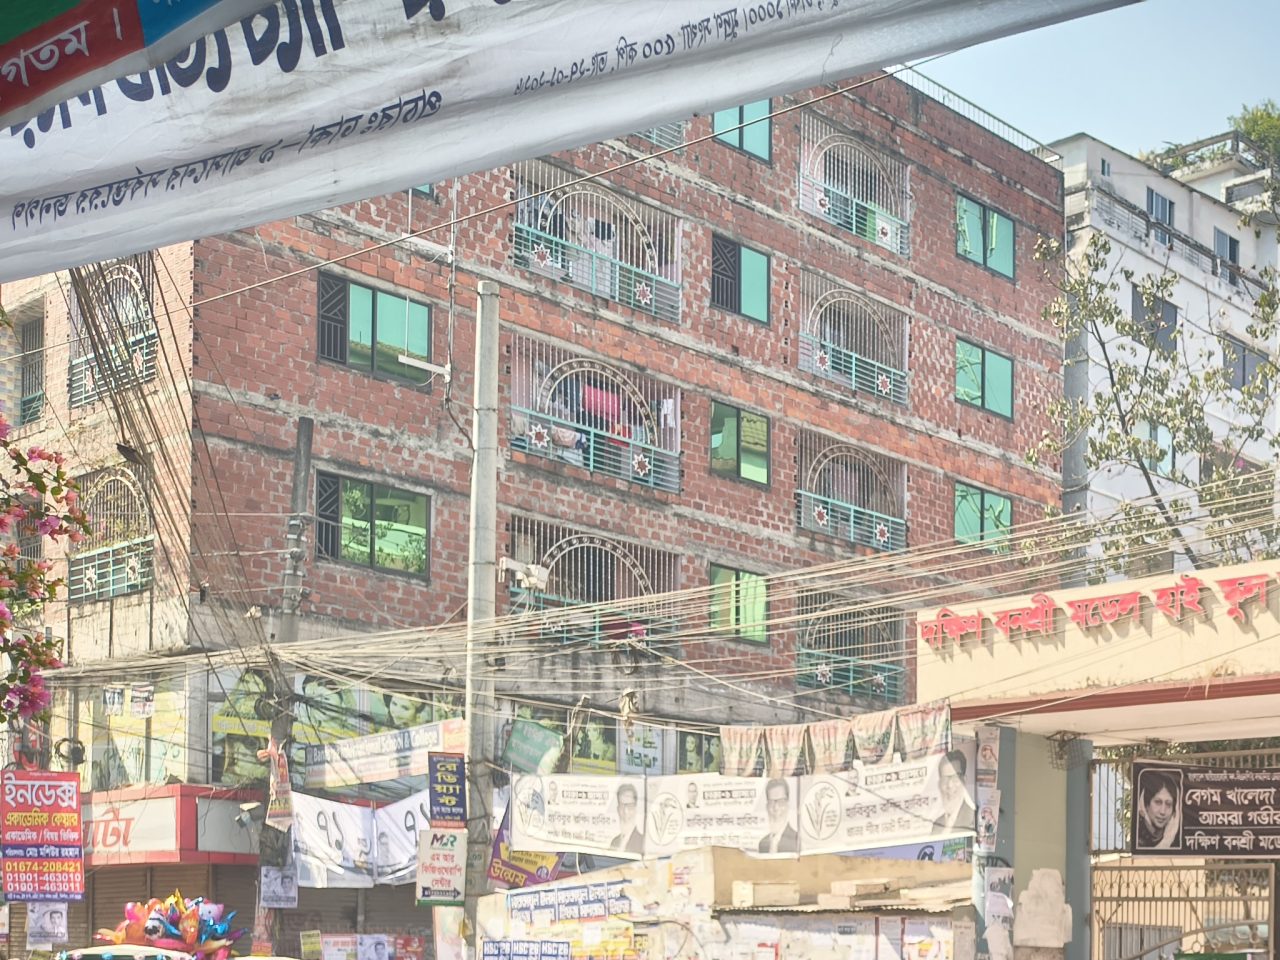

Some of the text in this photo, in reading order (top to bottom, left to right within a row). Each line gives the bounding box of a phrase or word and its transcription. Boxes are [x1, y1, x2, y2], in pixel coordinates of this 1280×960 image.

[1066, 591, 1141, 630] মডেল
[1152, 574, 1208, 622] হাই
[4, 772, 78, 810] ইনডেক্স
[1185, 787, 1222, 806] বেগম
[1226, 786, 1277, 805] খালেদা
[1199, 811, 1243, 825] আমরা
[5, 861, 81, 873] 01674-208421
